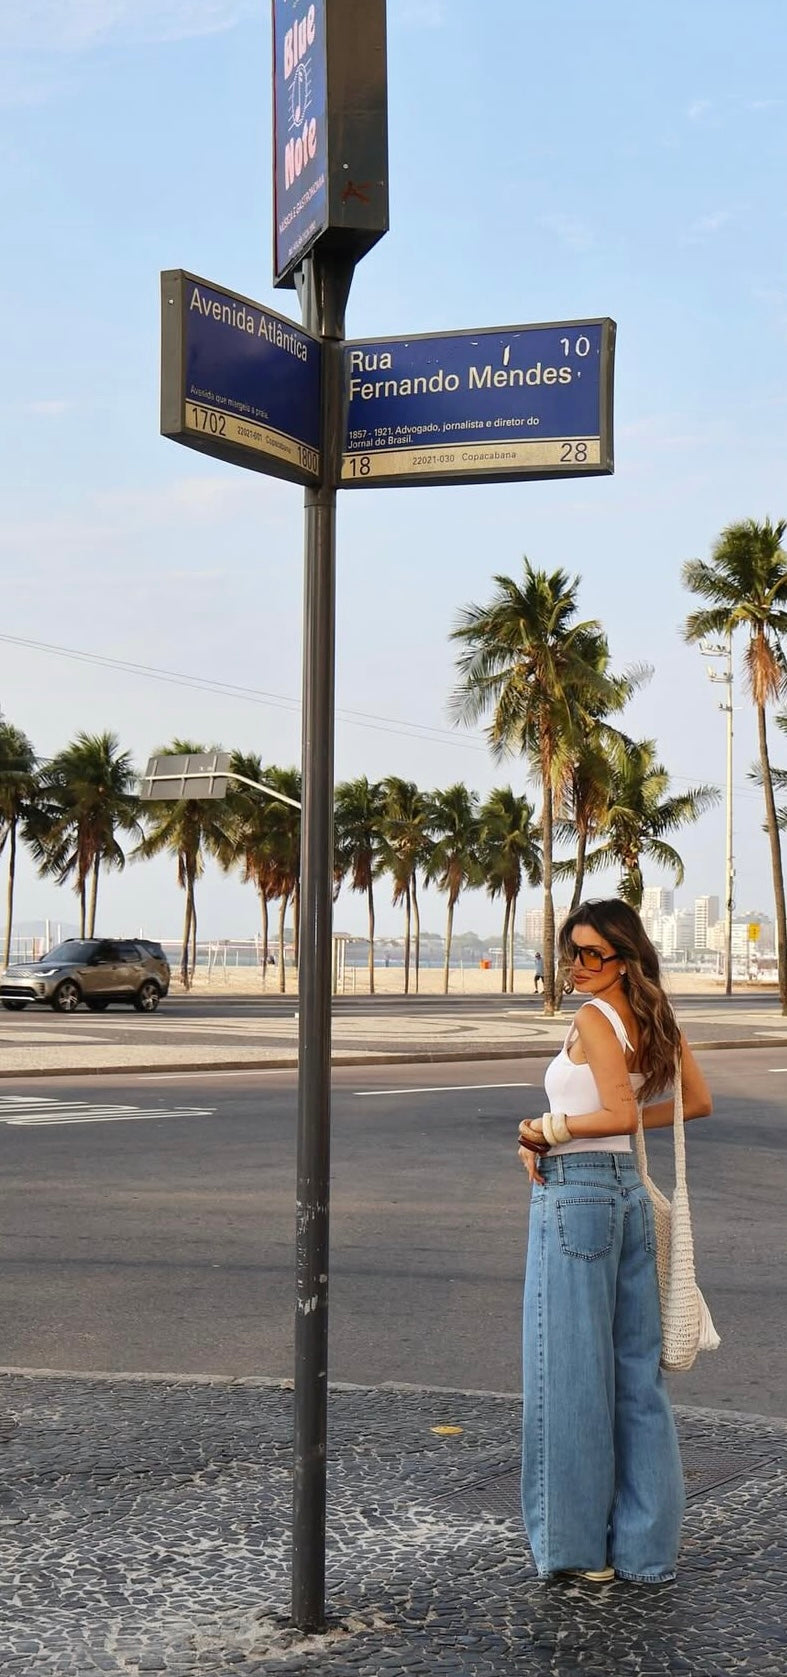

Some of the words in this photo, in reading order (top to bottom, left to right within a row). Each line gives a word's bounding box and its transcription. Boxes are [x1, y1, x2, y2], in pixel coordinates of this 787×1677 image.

[284, 4, 315, 80] Blue
[285, 117, 317, 191] Note
[190, 287, 254, 335] Avenida
[258, 315, 308, 362] Atlântica
[560, 336, 591, 357] 10
[350, 350, 392, 373] Rua
[350, 369, 460, 401] Fernando
[468, 362, 572, 389] Mendes
[192, 407, 226, 437] 1702
[395, 422, 441, 435] Advogado,
[443, 419, 484, 433] jornalista
[486, 420, 492, 428] e
[494, 417, 525, 428] diretor
[527, 416, 540, 426] do
[348, 438, 373, 449] Jornal
[375, 437, 386, 446] do
[388, 434, 413, 444] Brasil.
[560, 442, 587, 462] 28
[298, 446, 318, 473] 1800
[349, 456, 371, 477] 18
[412, 454, 455, 466] 22021-030
[462, 450, 517, 461] Copacabana
